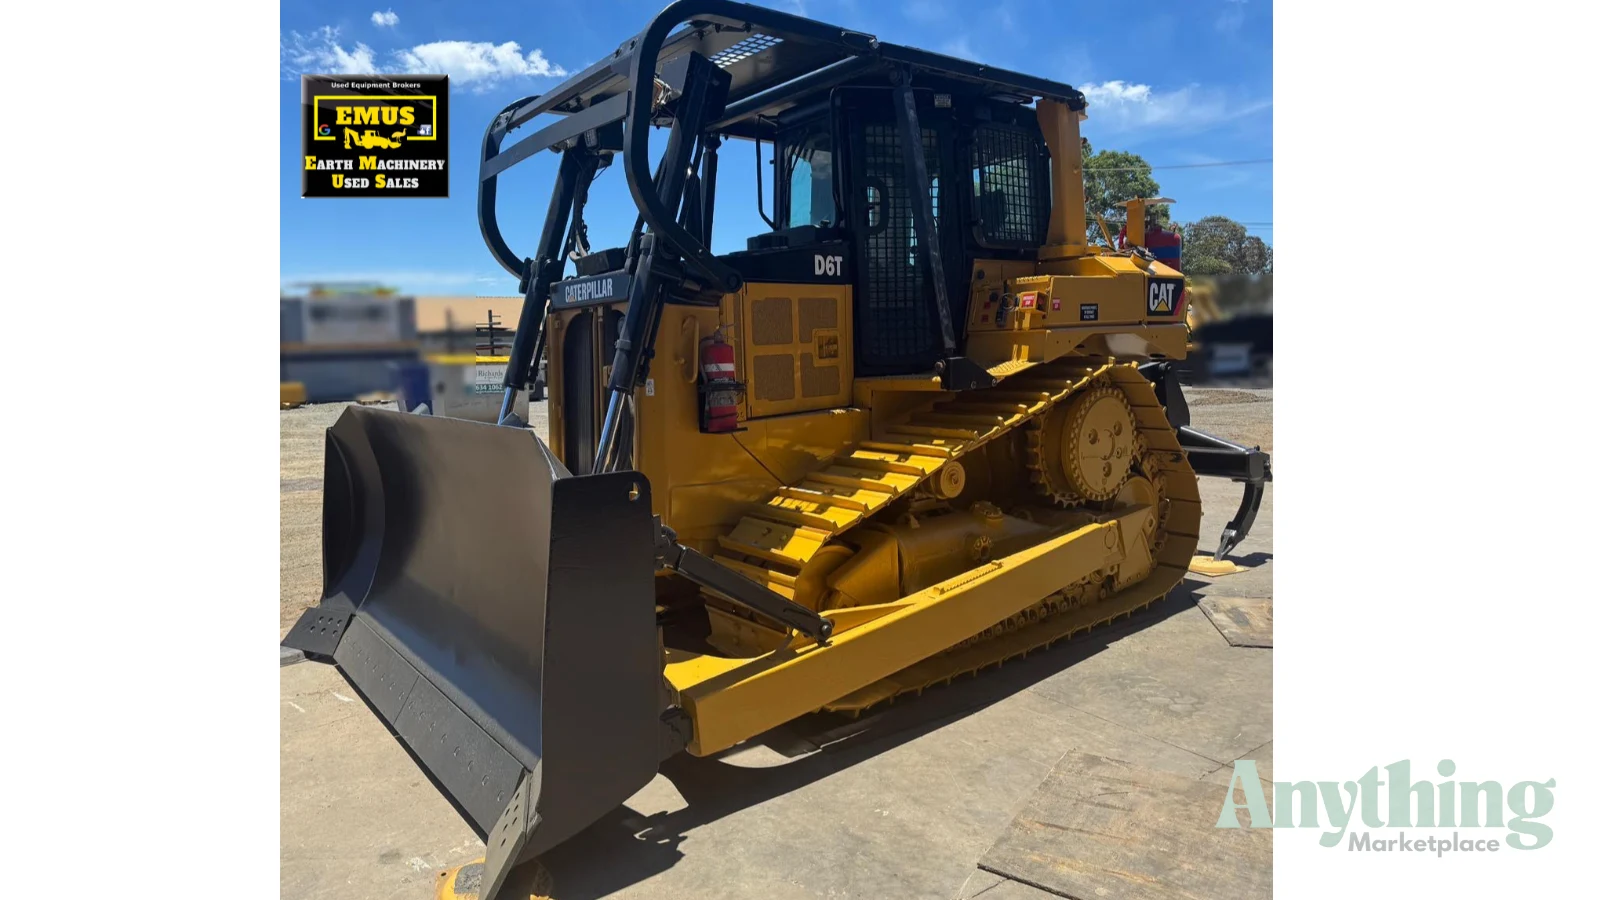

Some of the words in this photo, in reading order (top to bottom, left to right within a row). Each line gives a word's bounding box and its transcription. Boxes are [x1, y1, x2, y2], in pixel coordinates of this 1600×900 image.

[814, 254, 843, 277] D6T
[565, 278, 613, 303] CATERPILLAR
[1149, 282, 1175, 312] CAT
[478, 369, 503, 377] Richards
